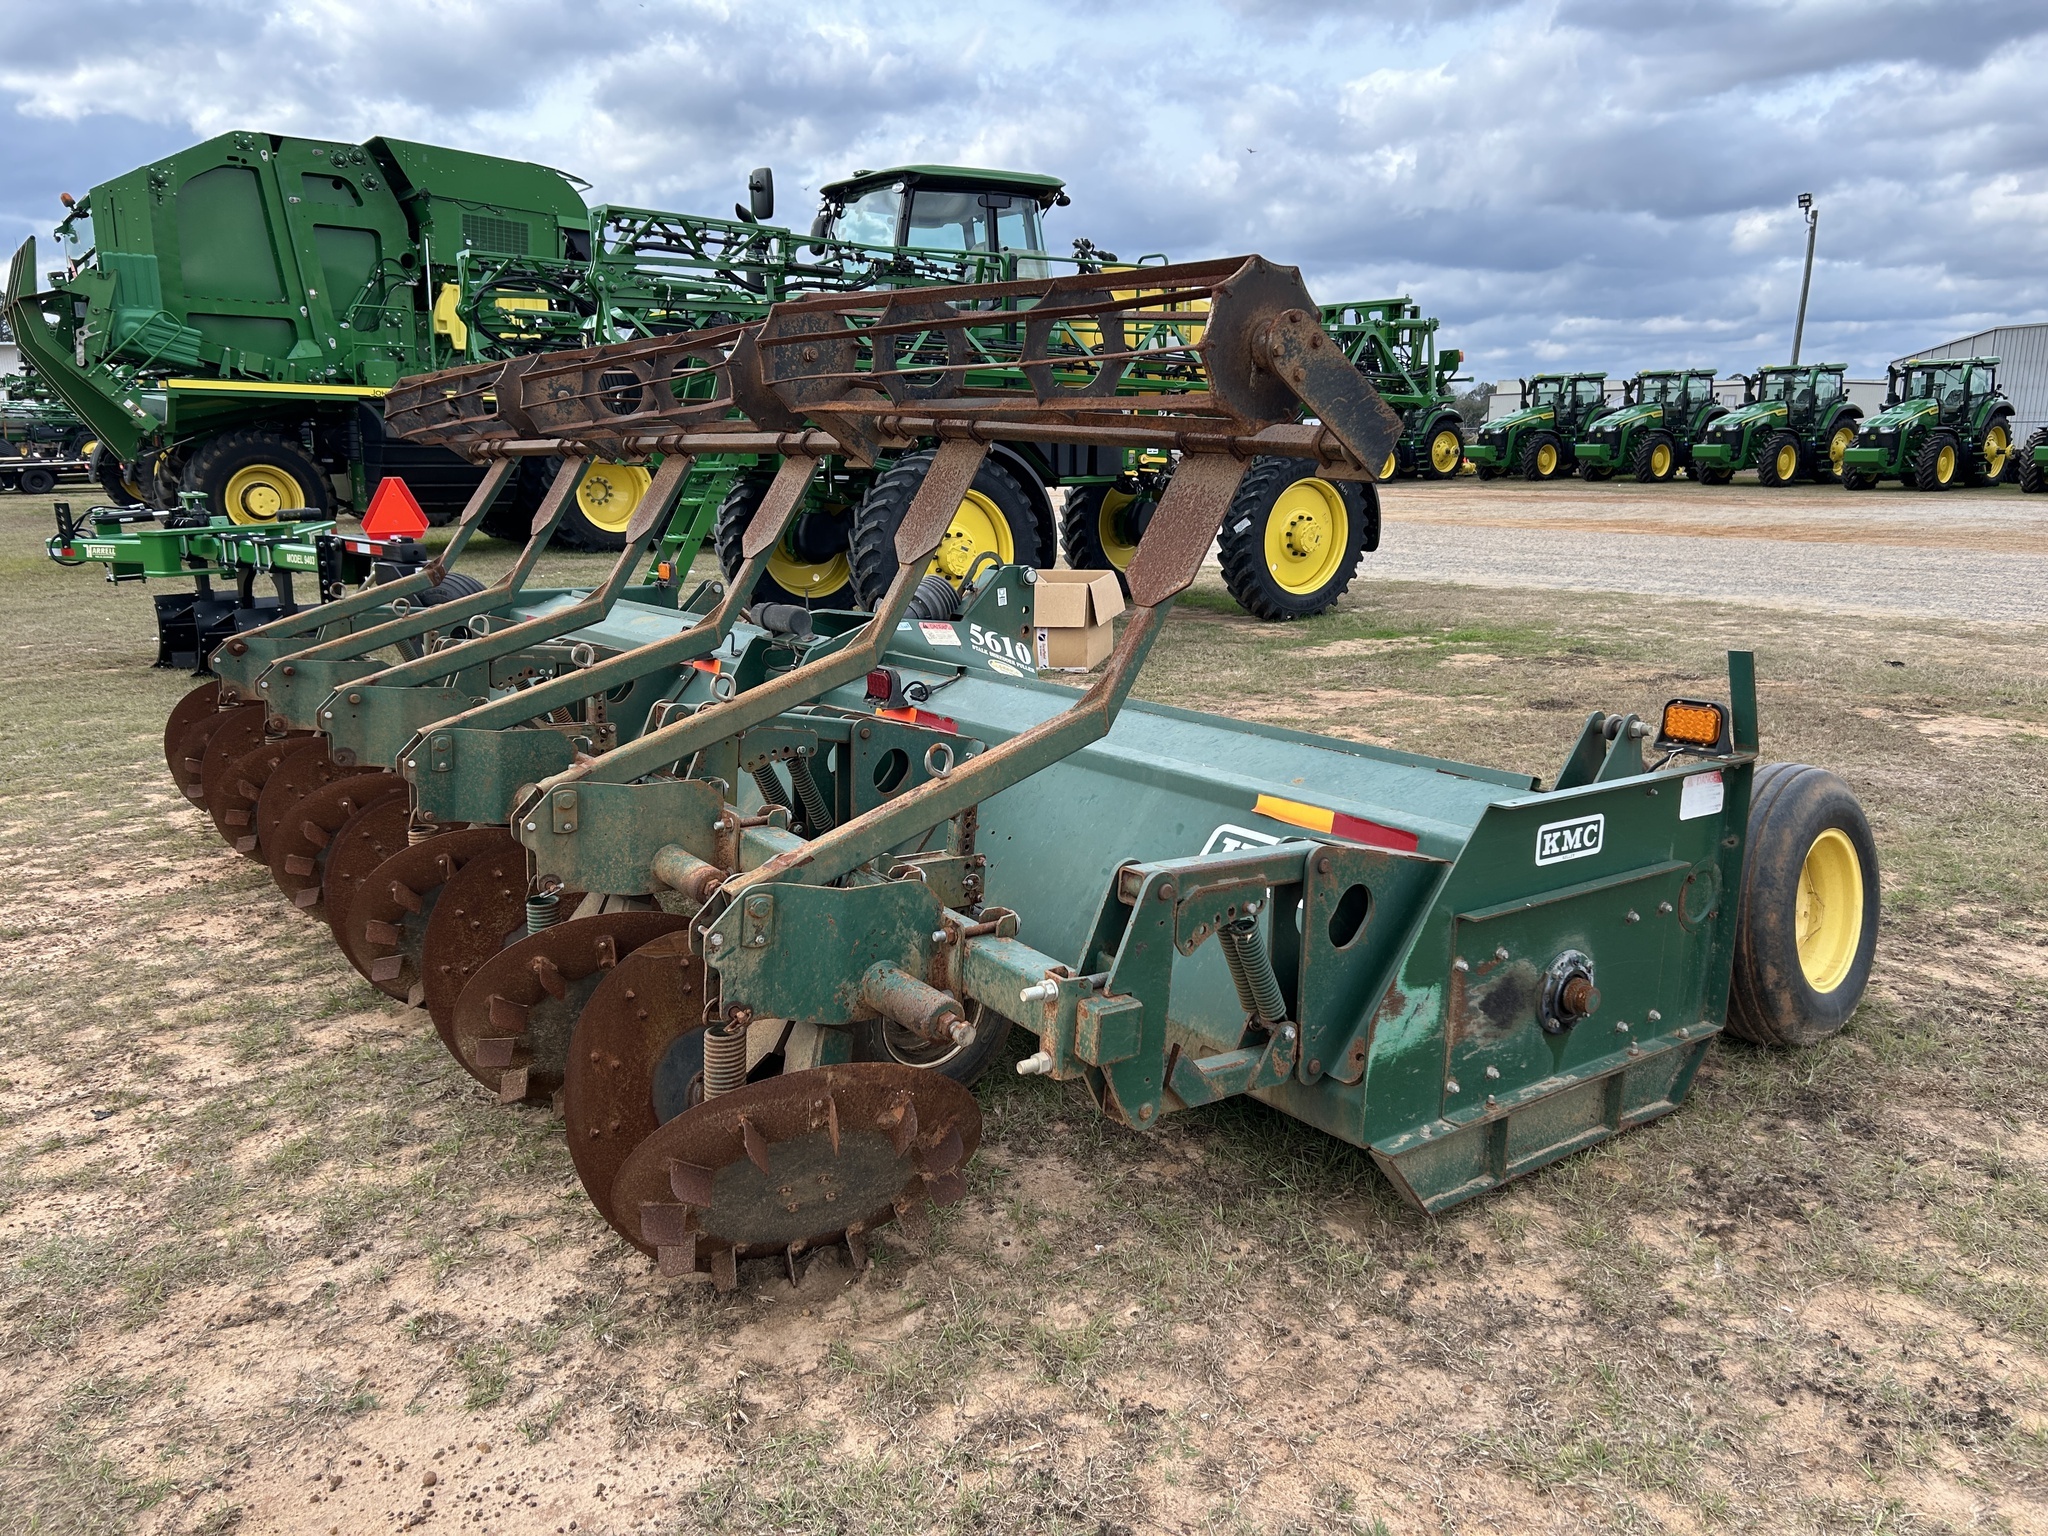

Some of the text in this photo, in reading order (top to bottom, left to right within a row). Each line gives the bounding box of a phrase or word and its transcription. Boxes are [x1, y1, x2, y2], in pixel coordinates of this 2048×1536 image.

[83, 544, 116, 558] HARRELL
[286, 553, 304, 564] MODEL
[969, 622, 1032, 665] 5610
[1015, 661, 1036, 674] PULLER
[1541, 823, 1599, 856] KMC
